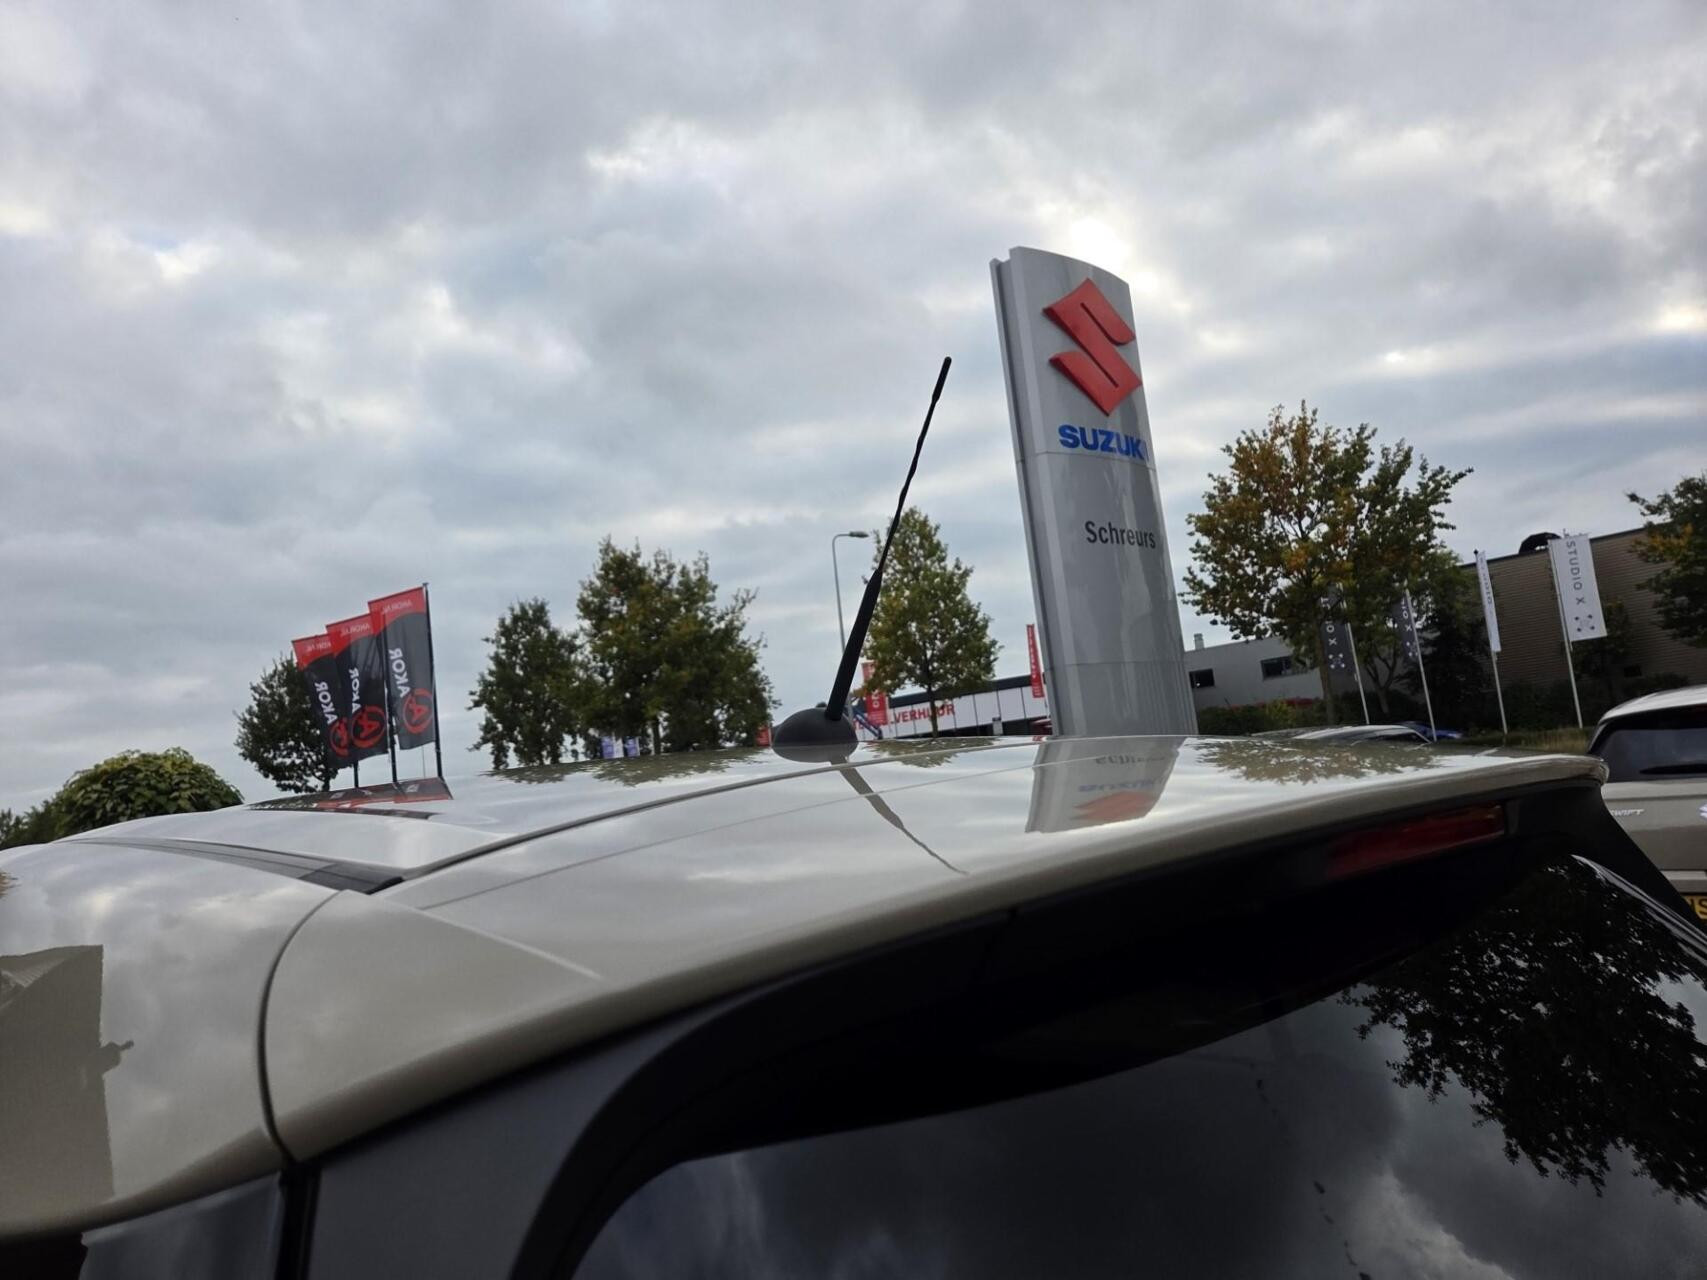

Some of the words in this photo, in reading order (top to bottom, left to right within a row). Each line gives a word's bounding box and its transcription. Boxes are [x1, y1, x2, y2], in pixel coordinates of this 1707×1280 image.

[1058, 424, 1149, 462] SUZUKI
[1085, 520, 1156, 550] Schreurs
[1565, 540, 1583, 591] STUDIO
[1575, 596, 1585, 605] X
